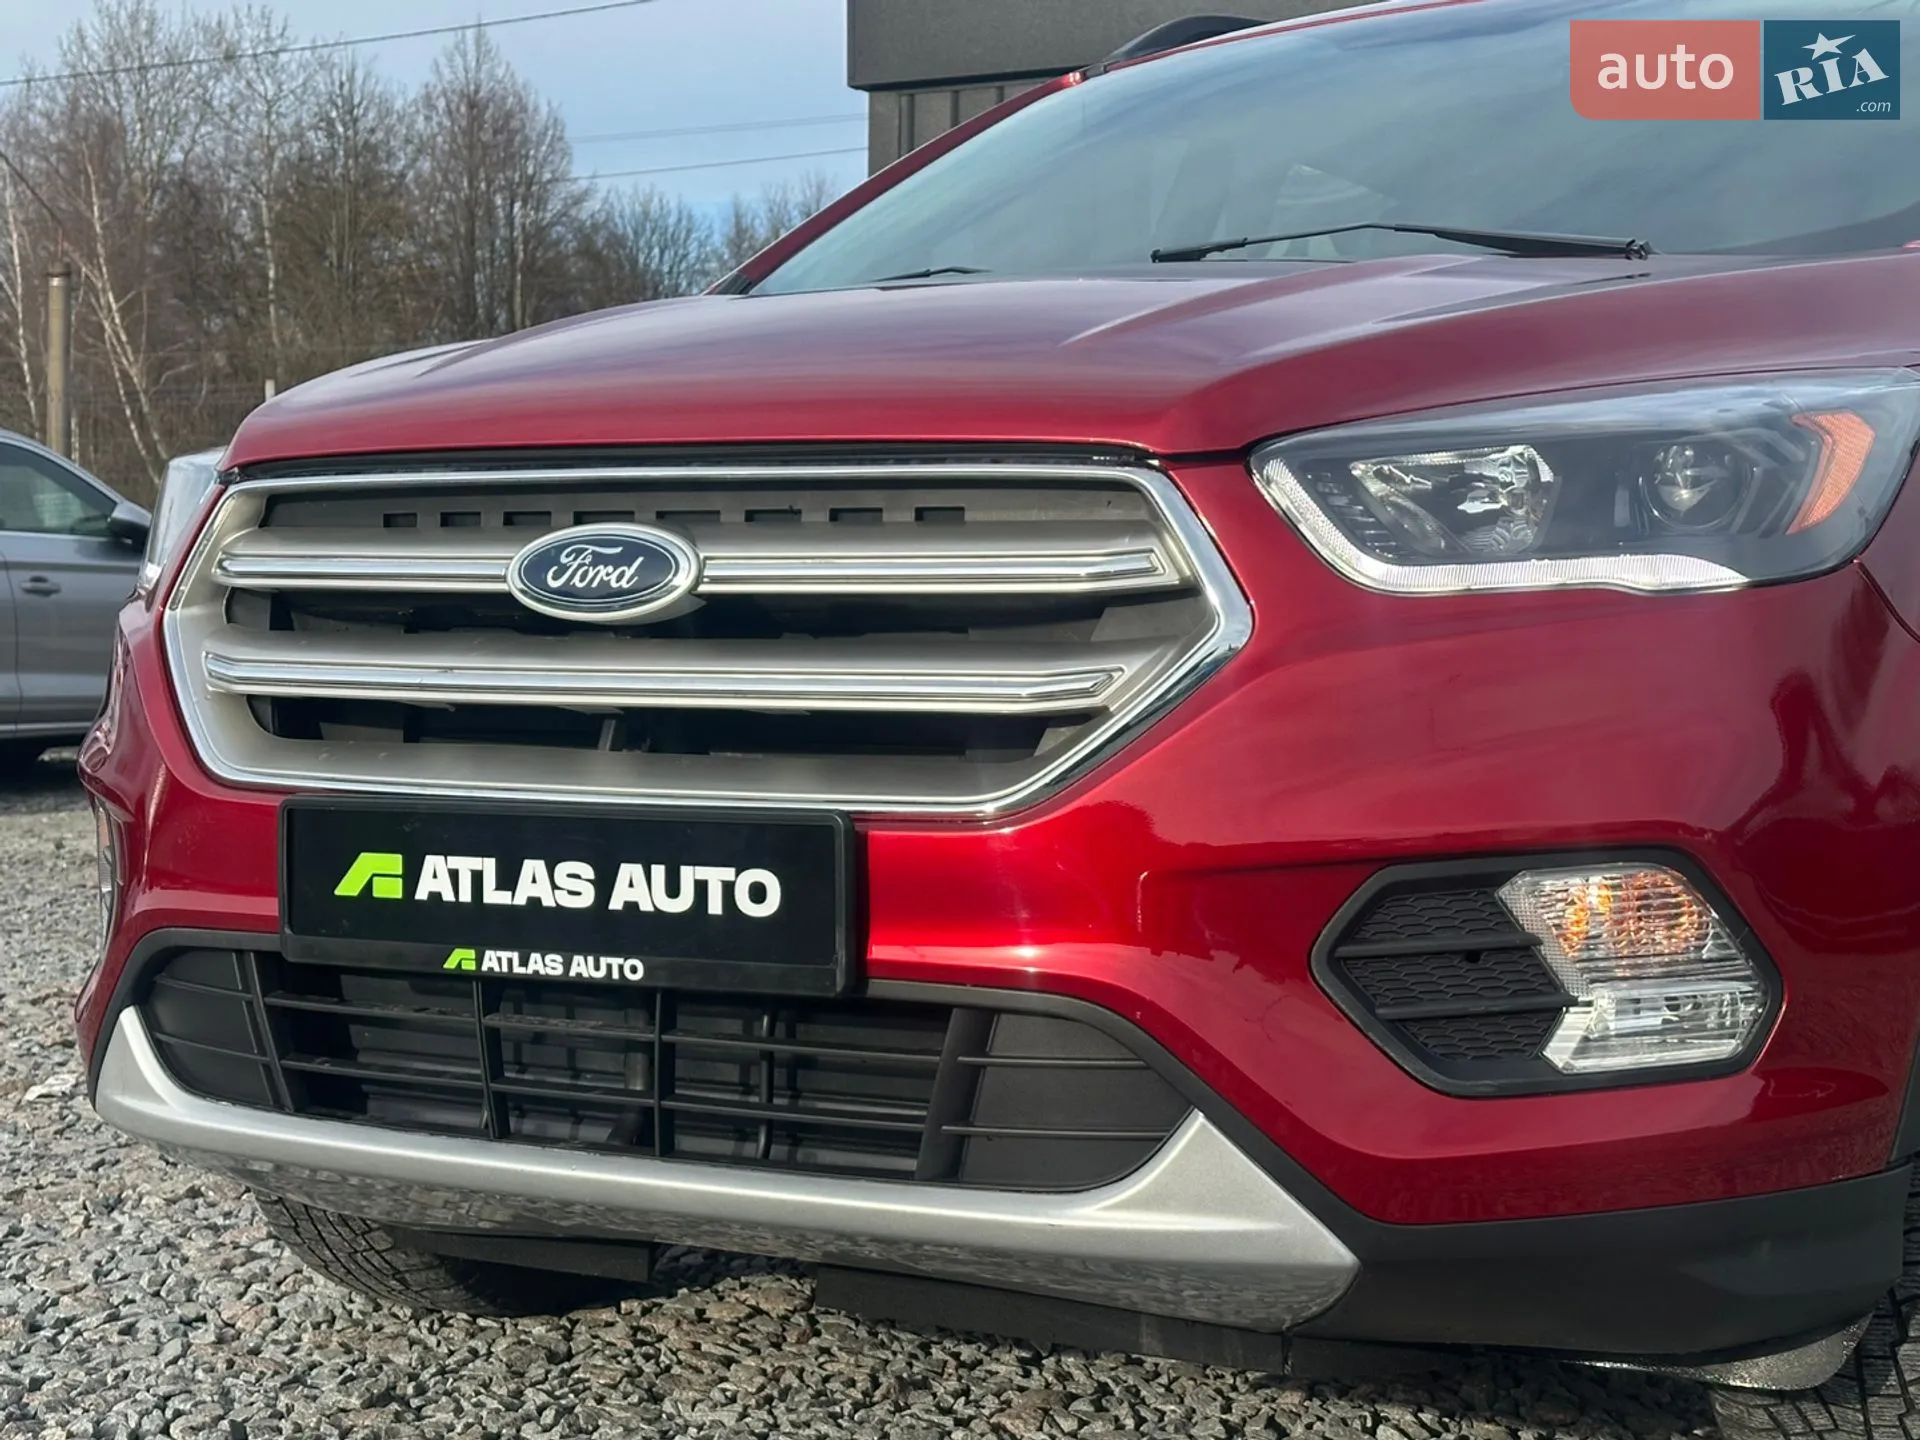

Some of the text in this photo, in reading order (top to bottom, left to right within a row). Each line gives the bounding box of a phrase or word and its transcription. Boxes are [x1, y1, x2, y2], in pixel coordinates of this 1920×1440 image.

[547, 544, 644, 589] Ford
[414, 854, 782, 918] ATLAS AUTO
[481, 949, 645, 981] ATLAS AUTO
